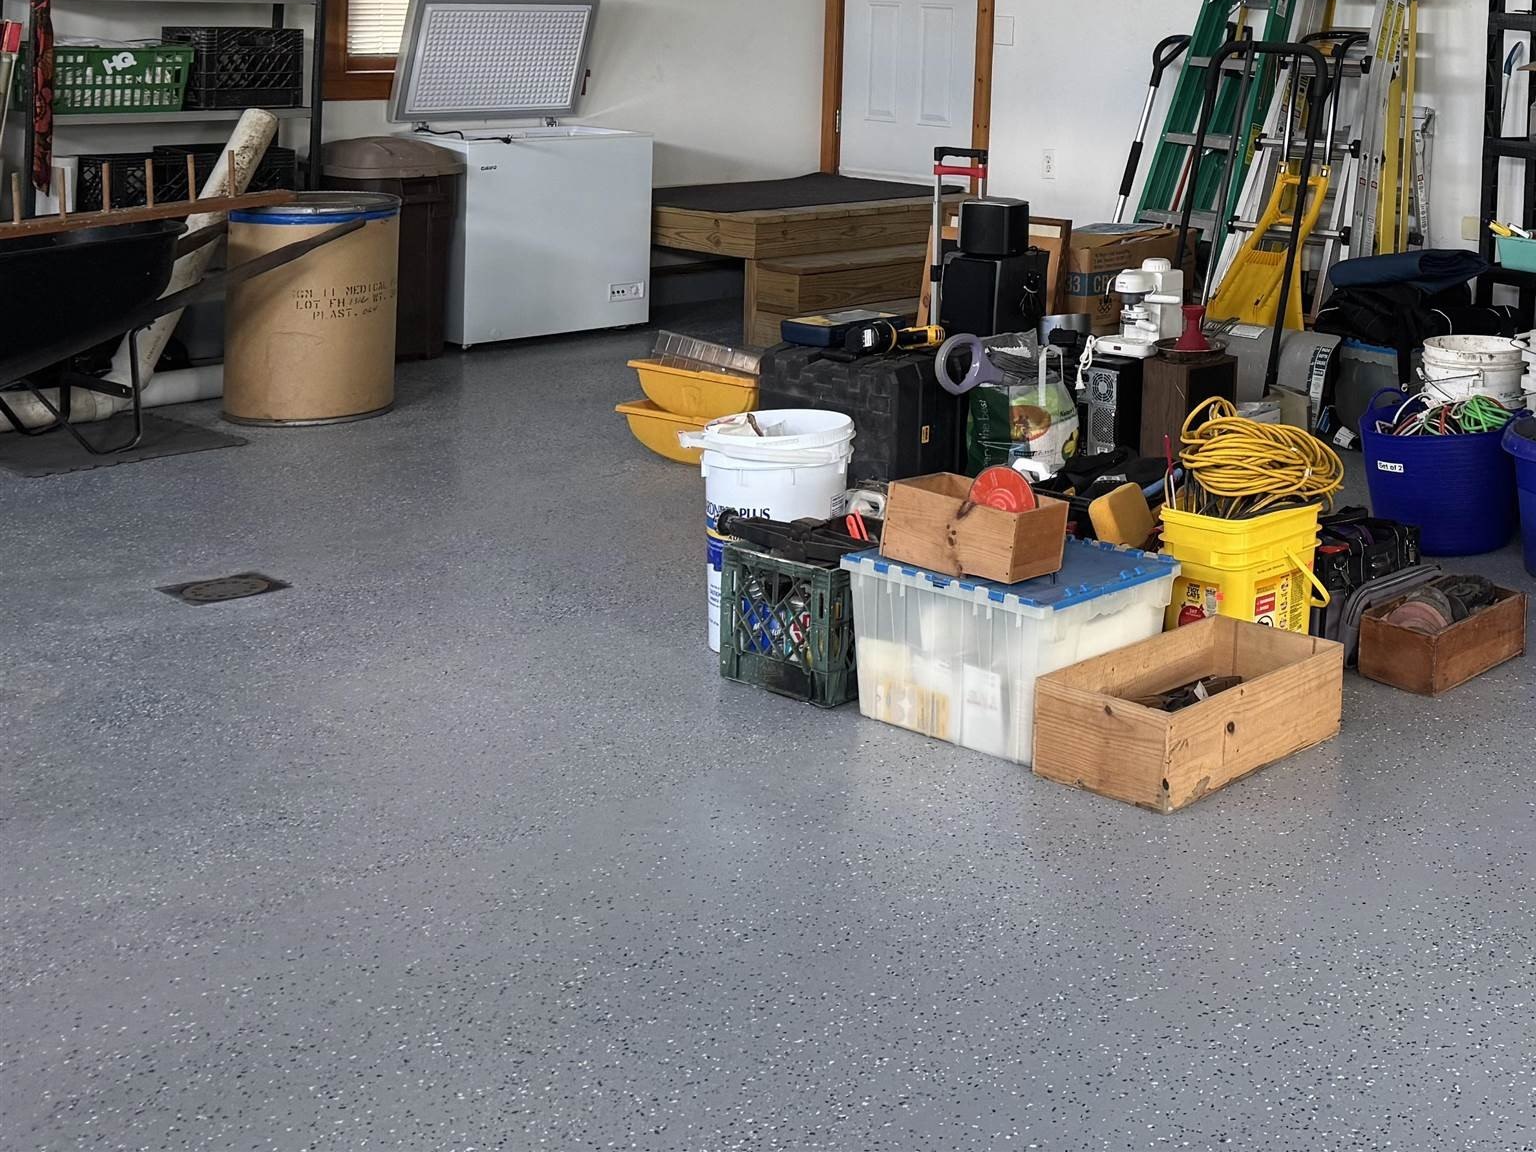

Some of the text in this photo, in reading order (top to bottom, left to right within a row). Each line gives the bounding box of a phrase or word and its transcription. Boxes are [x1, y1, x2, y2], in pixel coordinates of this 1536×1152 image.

[102, 51, 138, 75] HQ
[295, 299, 321, 310] LOT
[1378, 462, 1389, 470] Set
